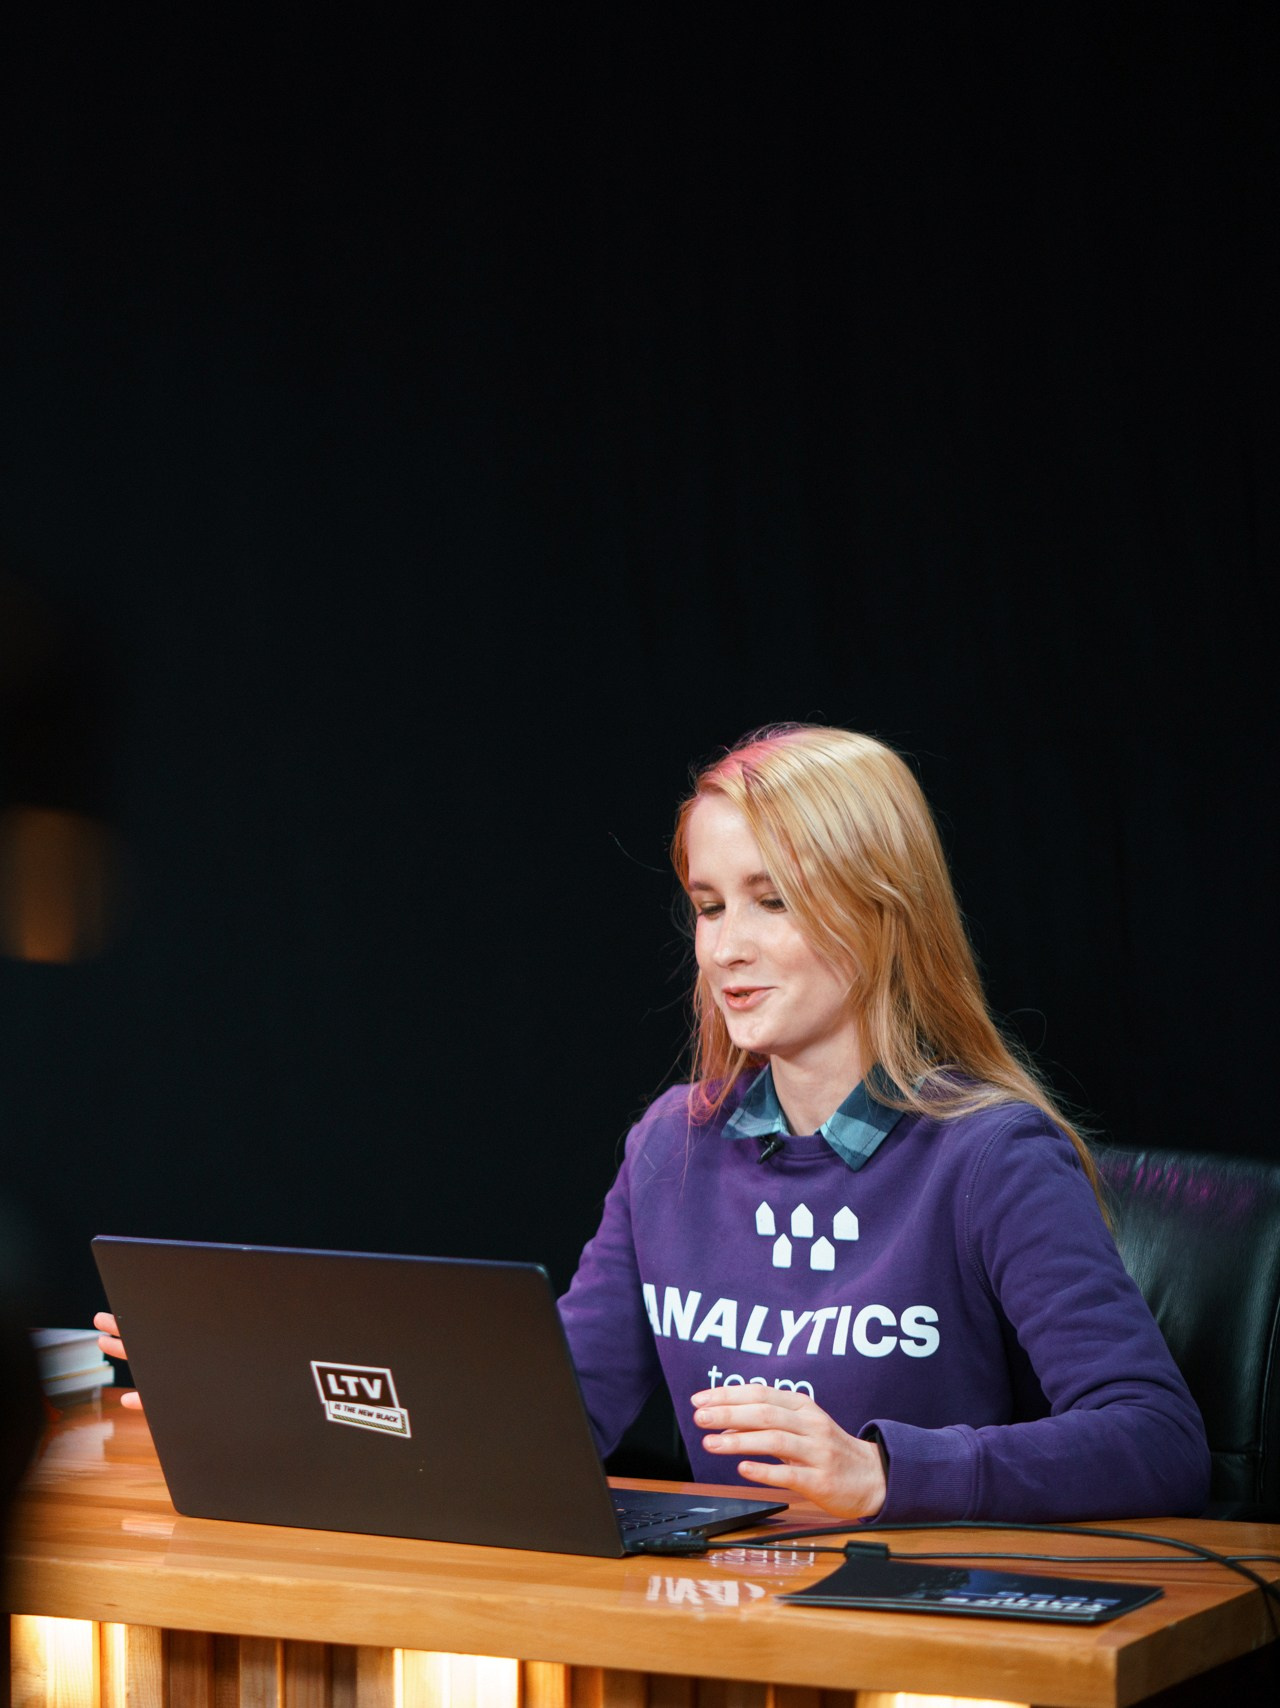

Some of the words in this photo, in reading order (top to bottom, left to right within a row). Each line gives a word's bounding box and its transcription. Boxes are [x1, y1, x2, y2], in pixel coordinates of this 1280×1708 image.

[643, 1283, 940, 1358] ANALYTICS
[326, 1373, 382, 1400] LTV
[334, 1403, 341, 1411] IS
[343, 1405, 356, 1414] THE
[358, 1408, 374, 1418] NEW
[376, 1412, 398, 1423] BLACK
